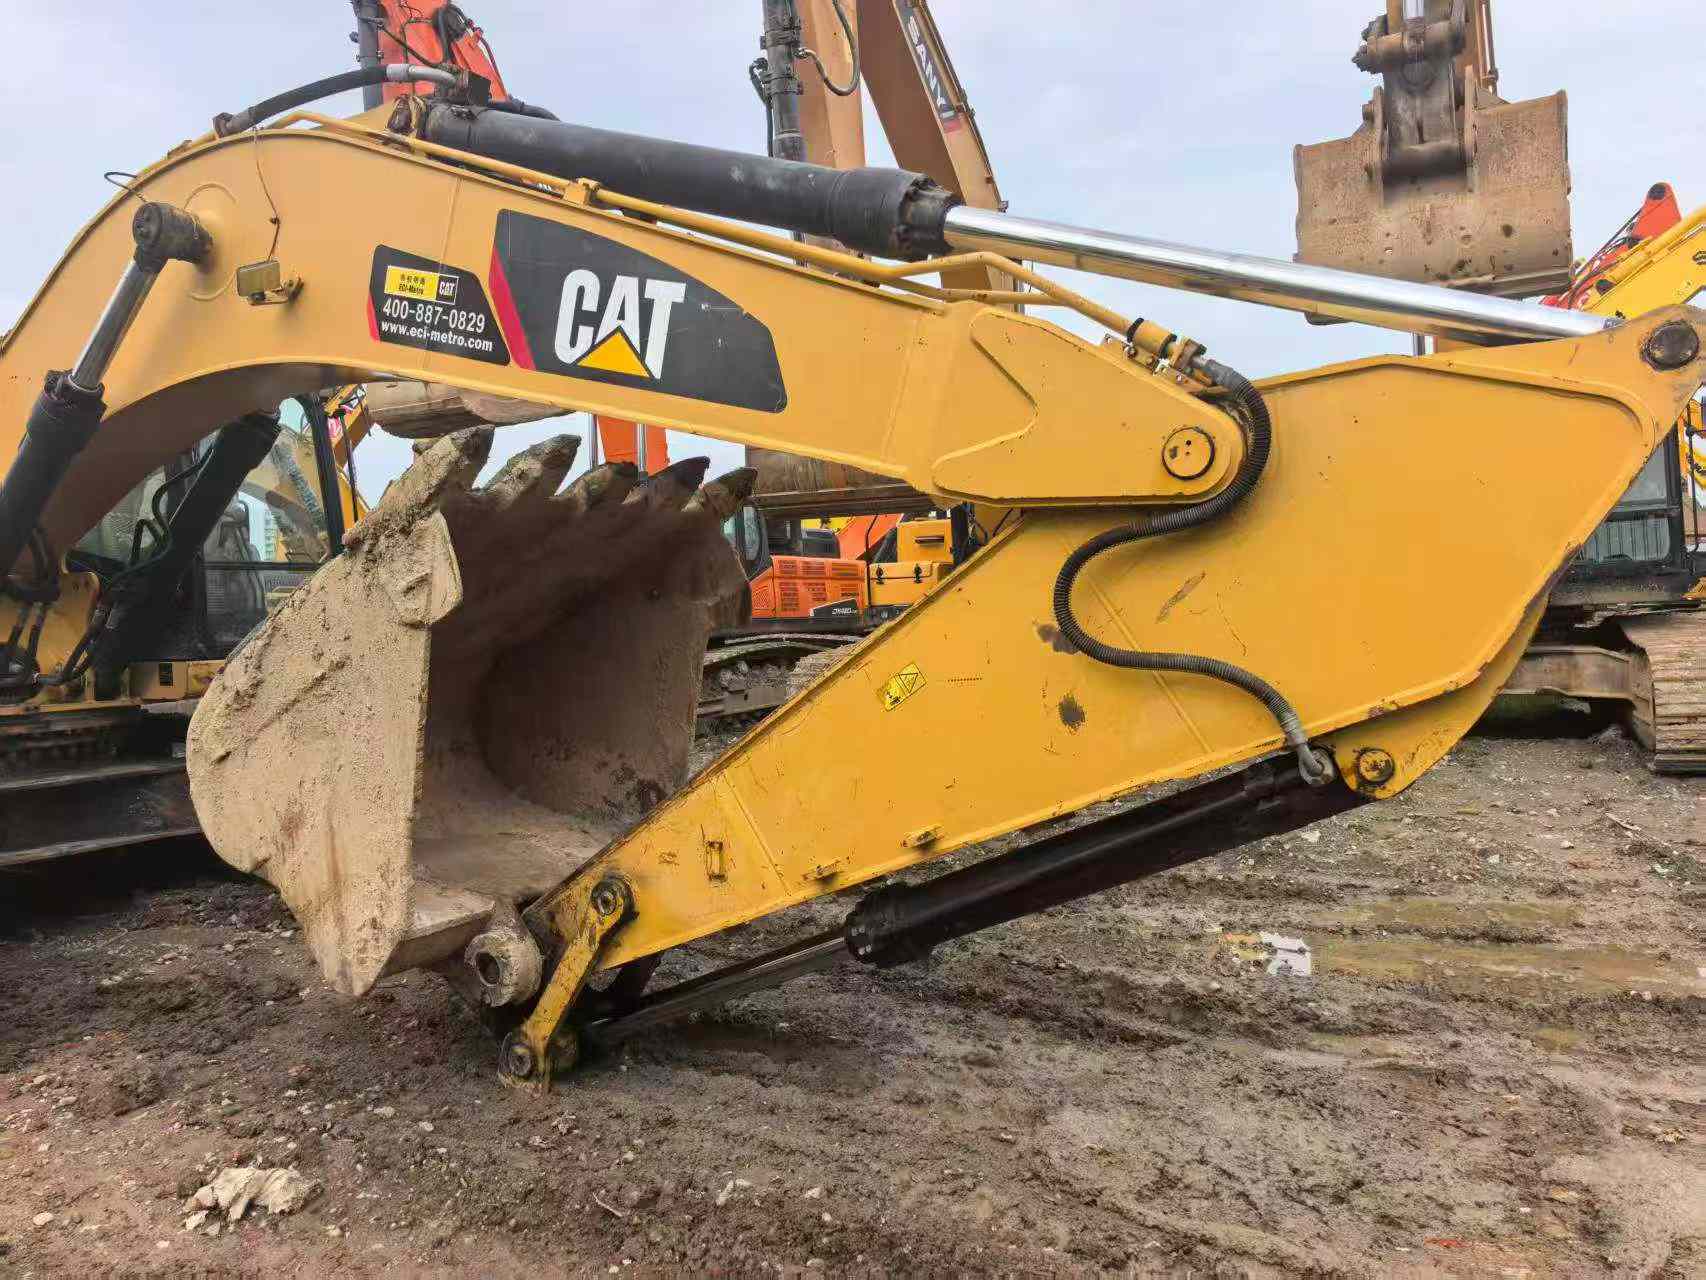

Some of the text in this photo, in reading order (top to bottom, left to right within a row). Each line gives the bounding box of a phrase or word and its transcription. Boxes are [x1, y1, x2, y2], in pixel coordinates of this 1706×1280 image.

[439, 281, 455, 296] CAT
[382, 298, 486, 334] 400-887-0829
[554, 269, 687, 380] CAT
[381, 320, 494, 352] www.eci-metro.com
